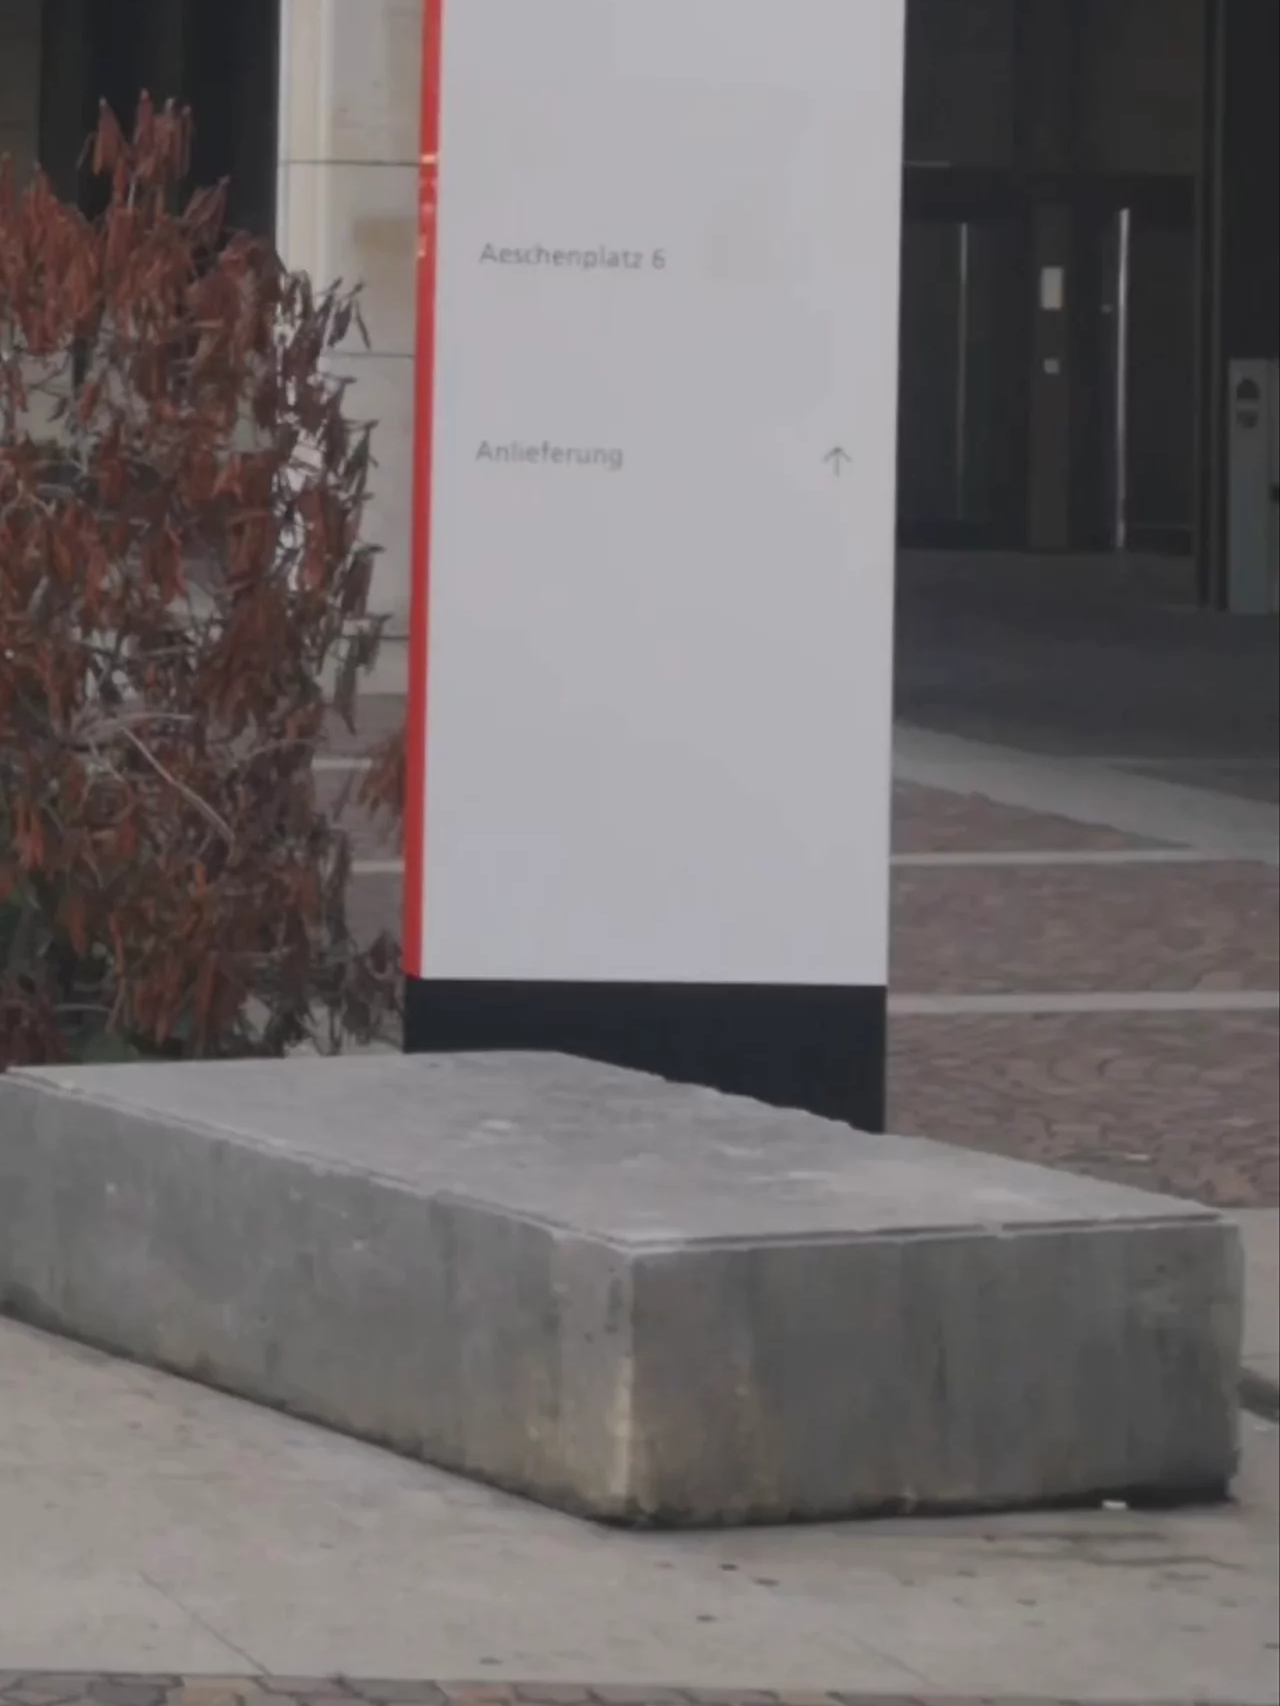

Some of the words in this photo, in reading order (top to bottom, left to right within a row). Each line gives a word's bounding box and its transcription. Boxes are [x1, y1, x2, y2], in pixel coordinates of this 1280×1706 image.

[478, 242, 644, 271] Aeschenplatz
[651, 247, 667, 270] 6
[475, 439, 624, 472] Anlieferung
